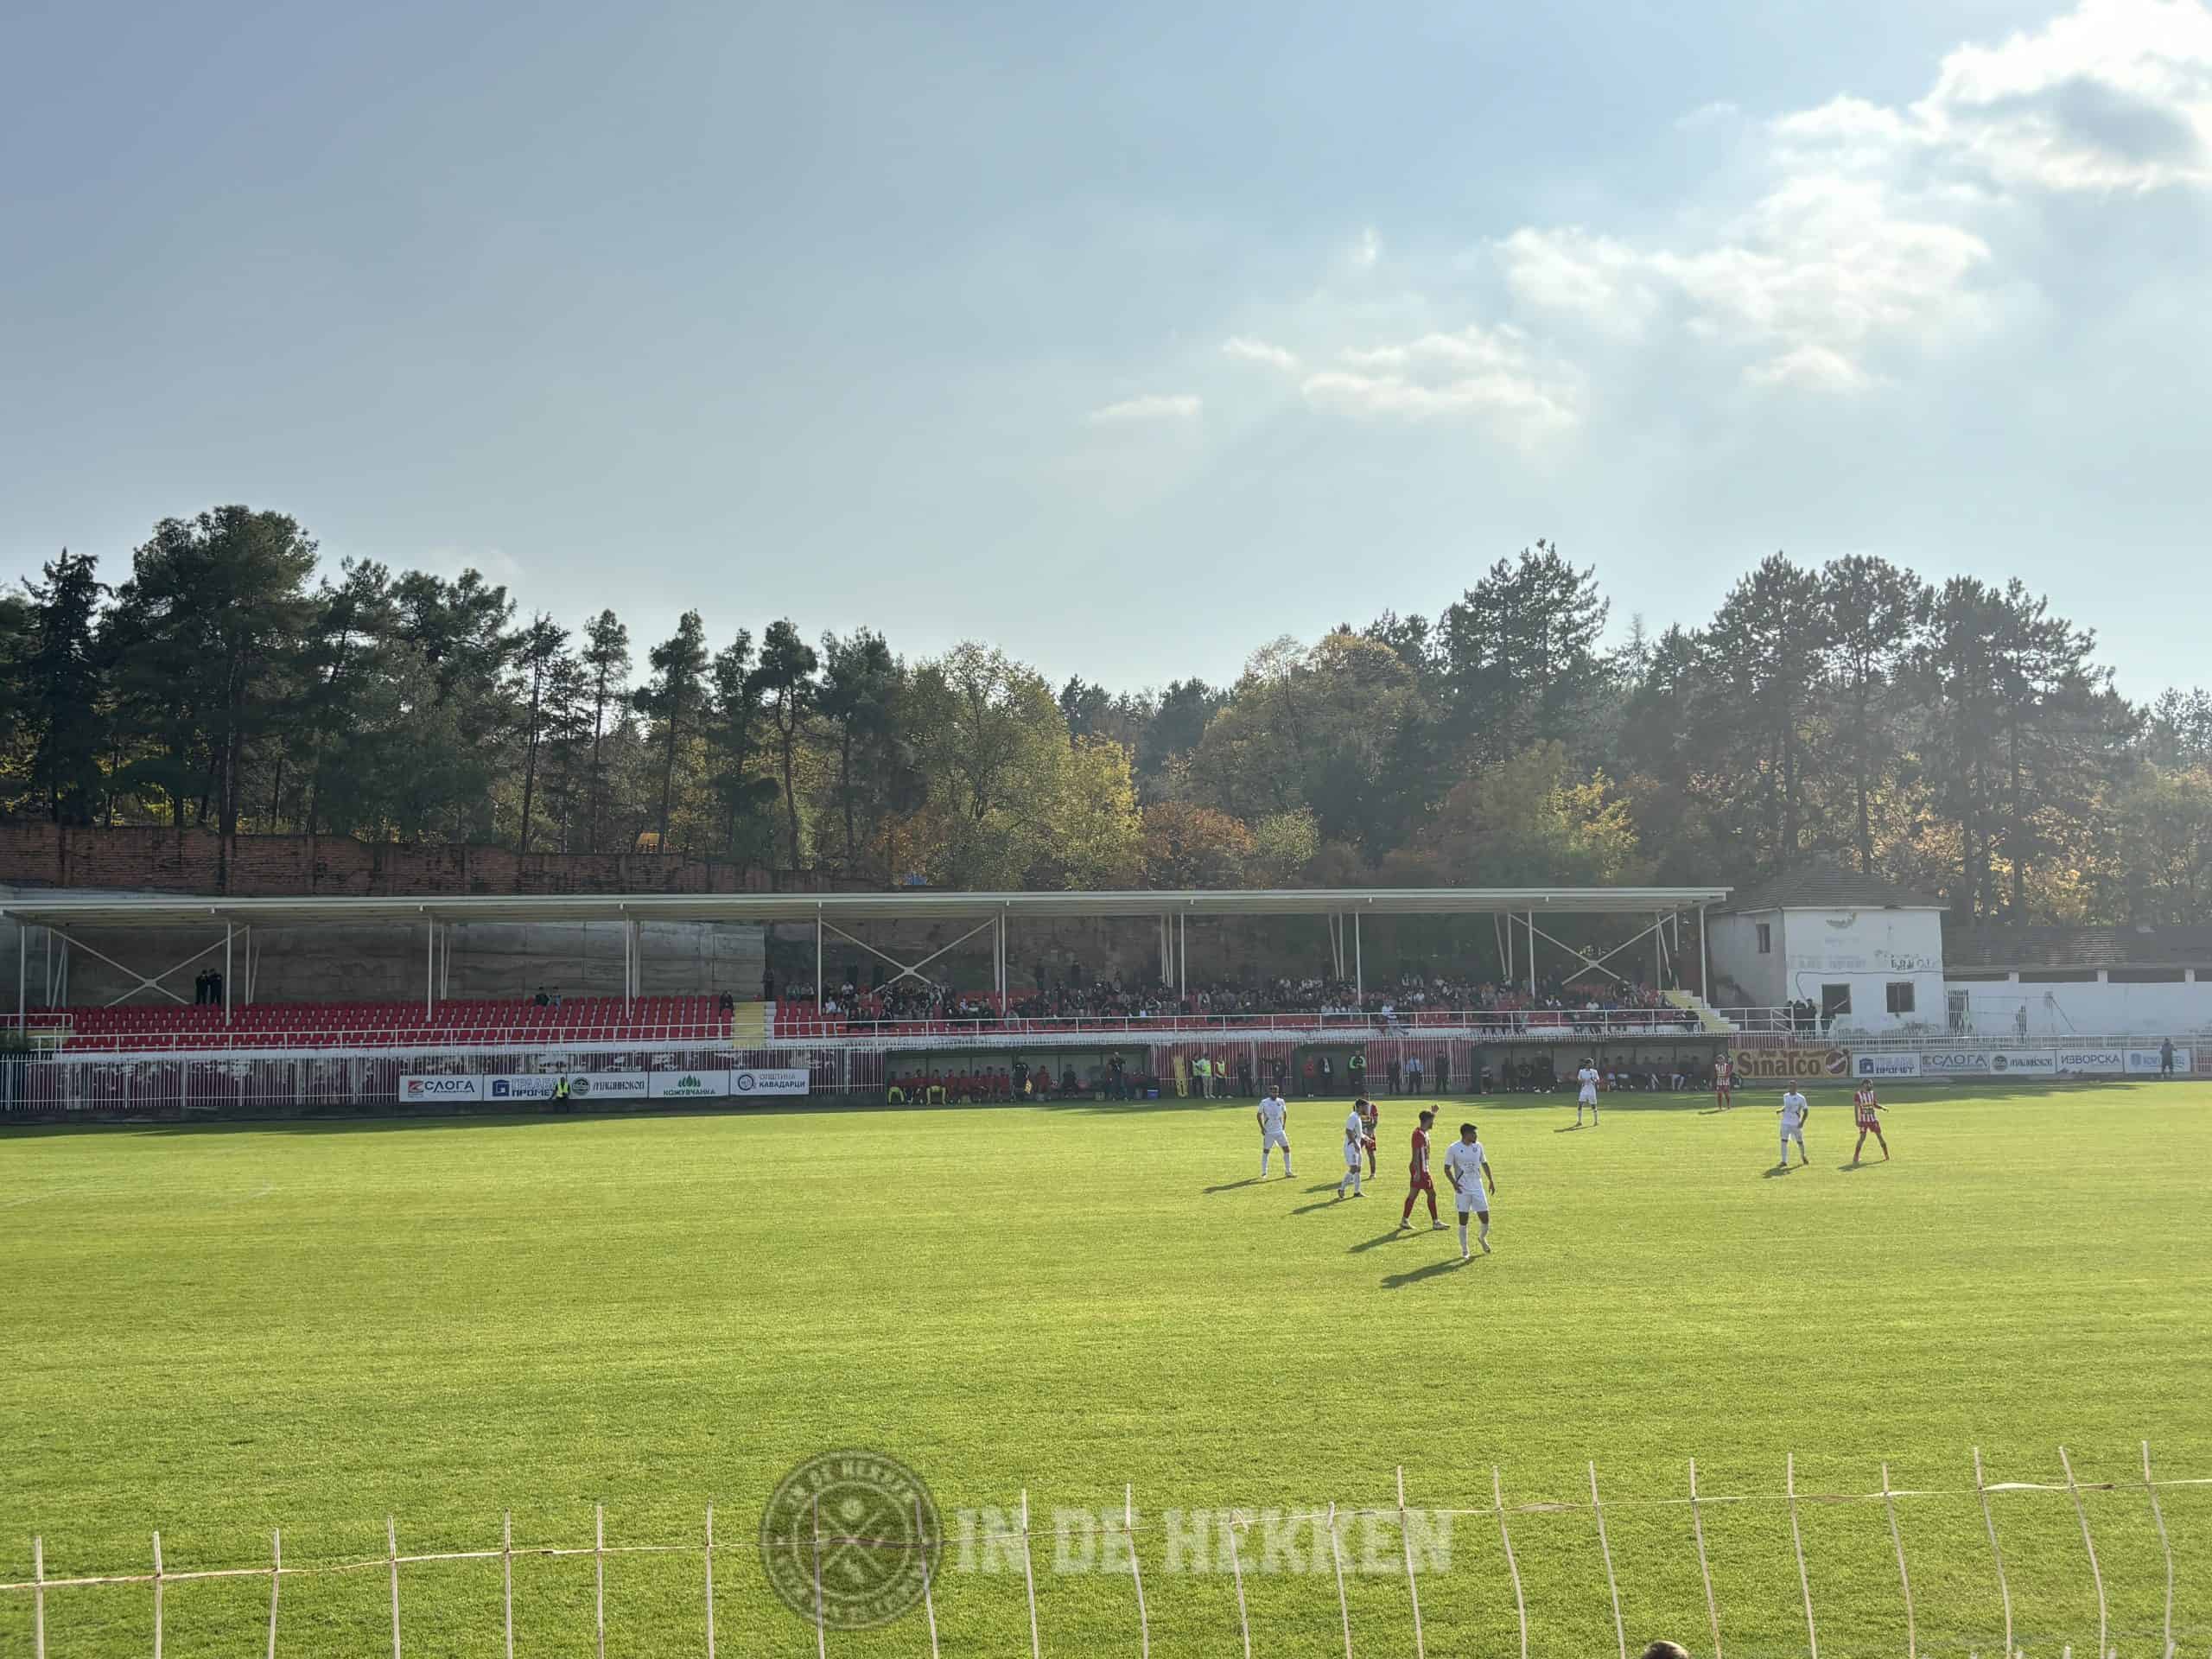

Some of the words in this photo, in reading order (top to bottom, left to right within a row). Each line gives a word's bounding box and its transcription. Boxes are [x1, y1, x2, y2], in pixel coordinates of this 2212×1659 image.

[1737, 1051, 1821, 1077] Sinalco
[1932, 1054, 1986, 1066] СЛОГА
[2061, 1054, 2120, 1065] ИЗВОРСКА
[424, 1080, 475, 1093] СЛОГА
[759, 1080, 805, 1089] КАВАДАРЦИ
